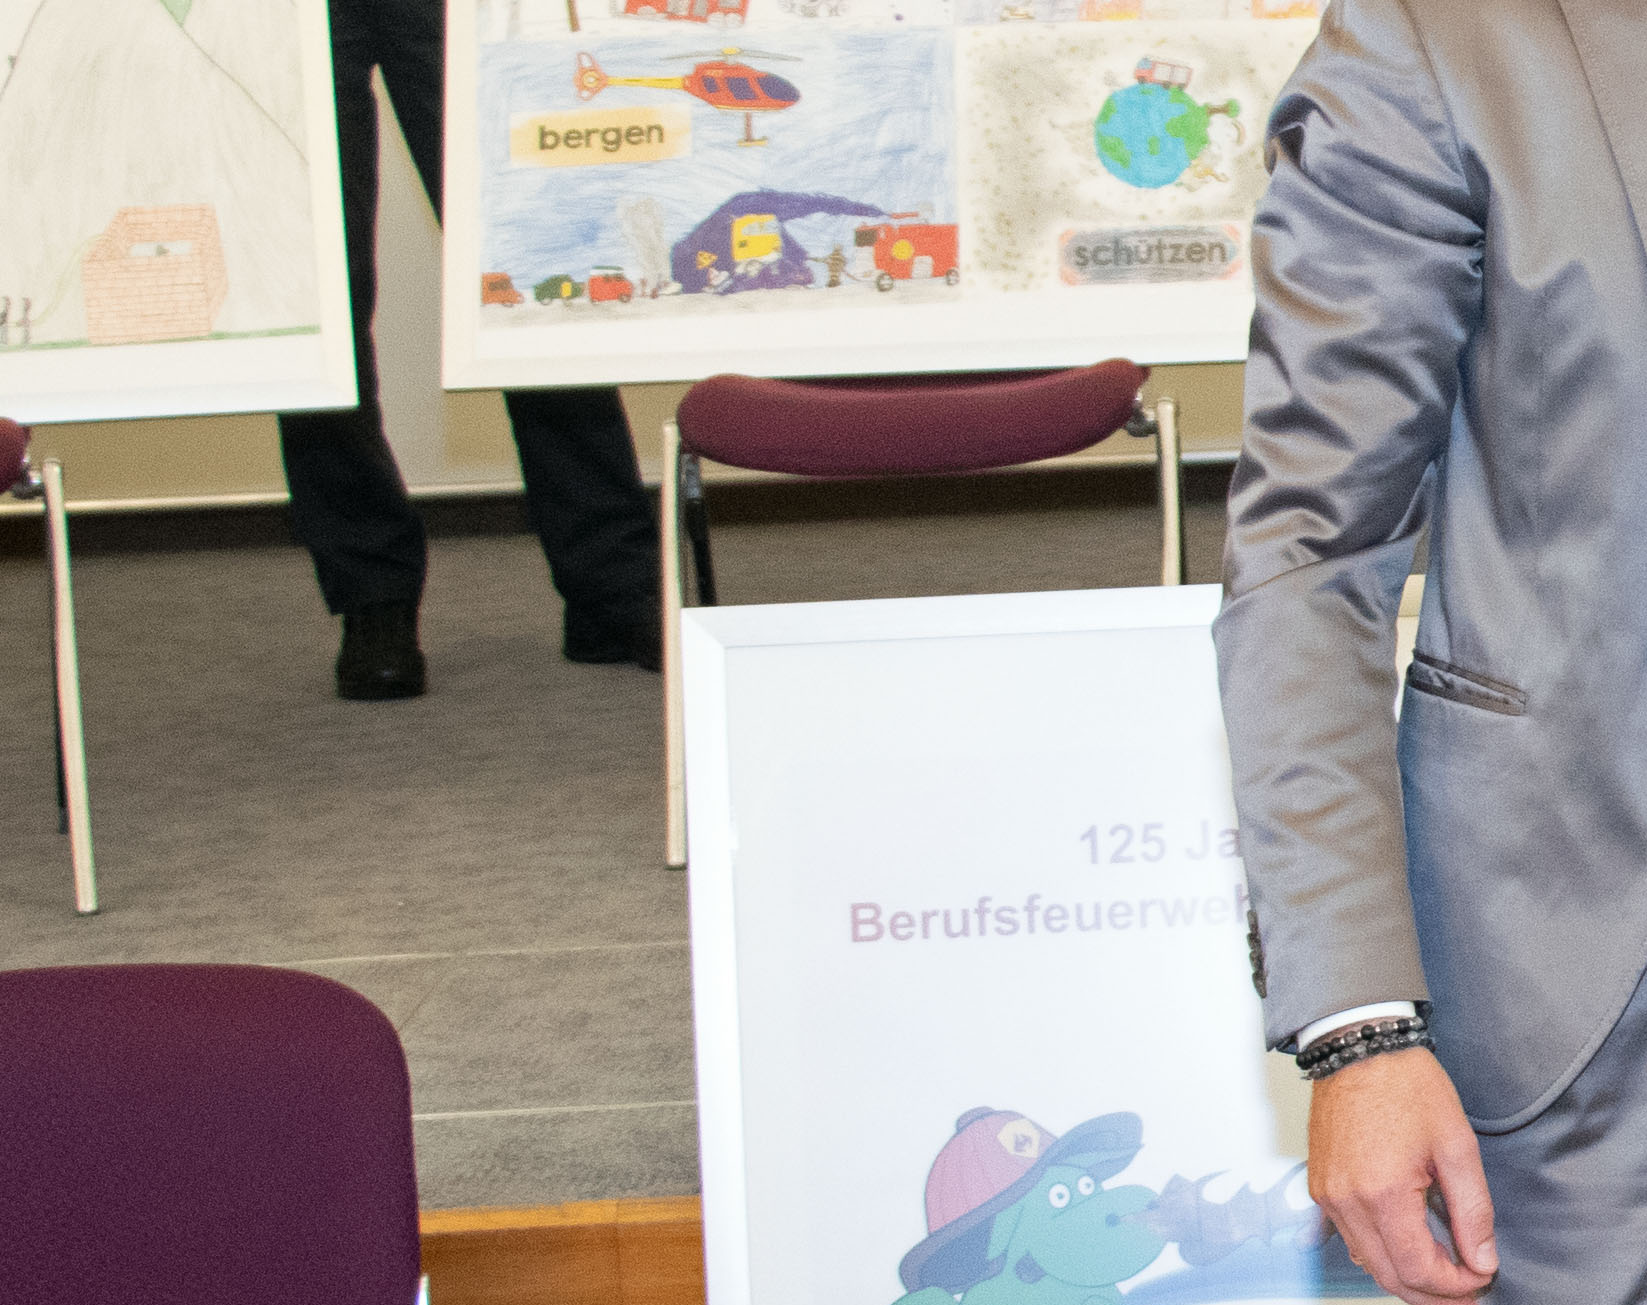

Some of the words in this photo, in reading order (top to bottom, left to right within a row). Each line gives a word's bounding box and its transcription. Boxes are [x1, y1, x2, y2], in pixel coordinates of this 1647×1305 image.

[538, 123, 664, 153] bergen
[1074, 236, 1228, 267] schützen
[1079, 821, 1168, 865] 125
